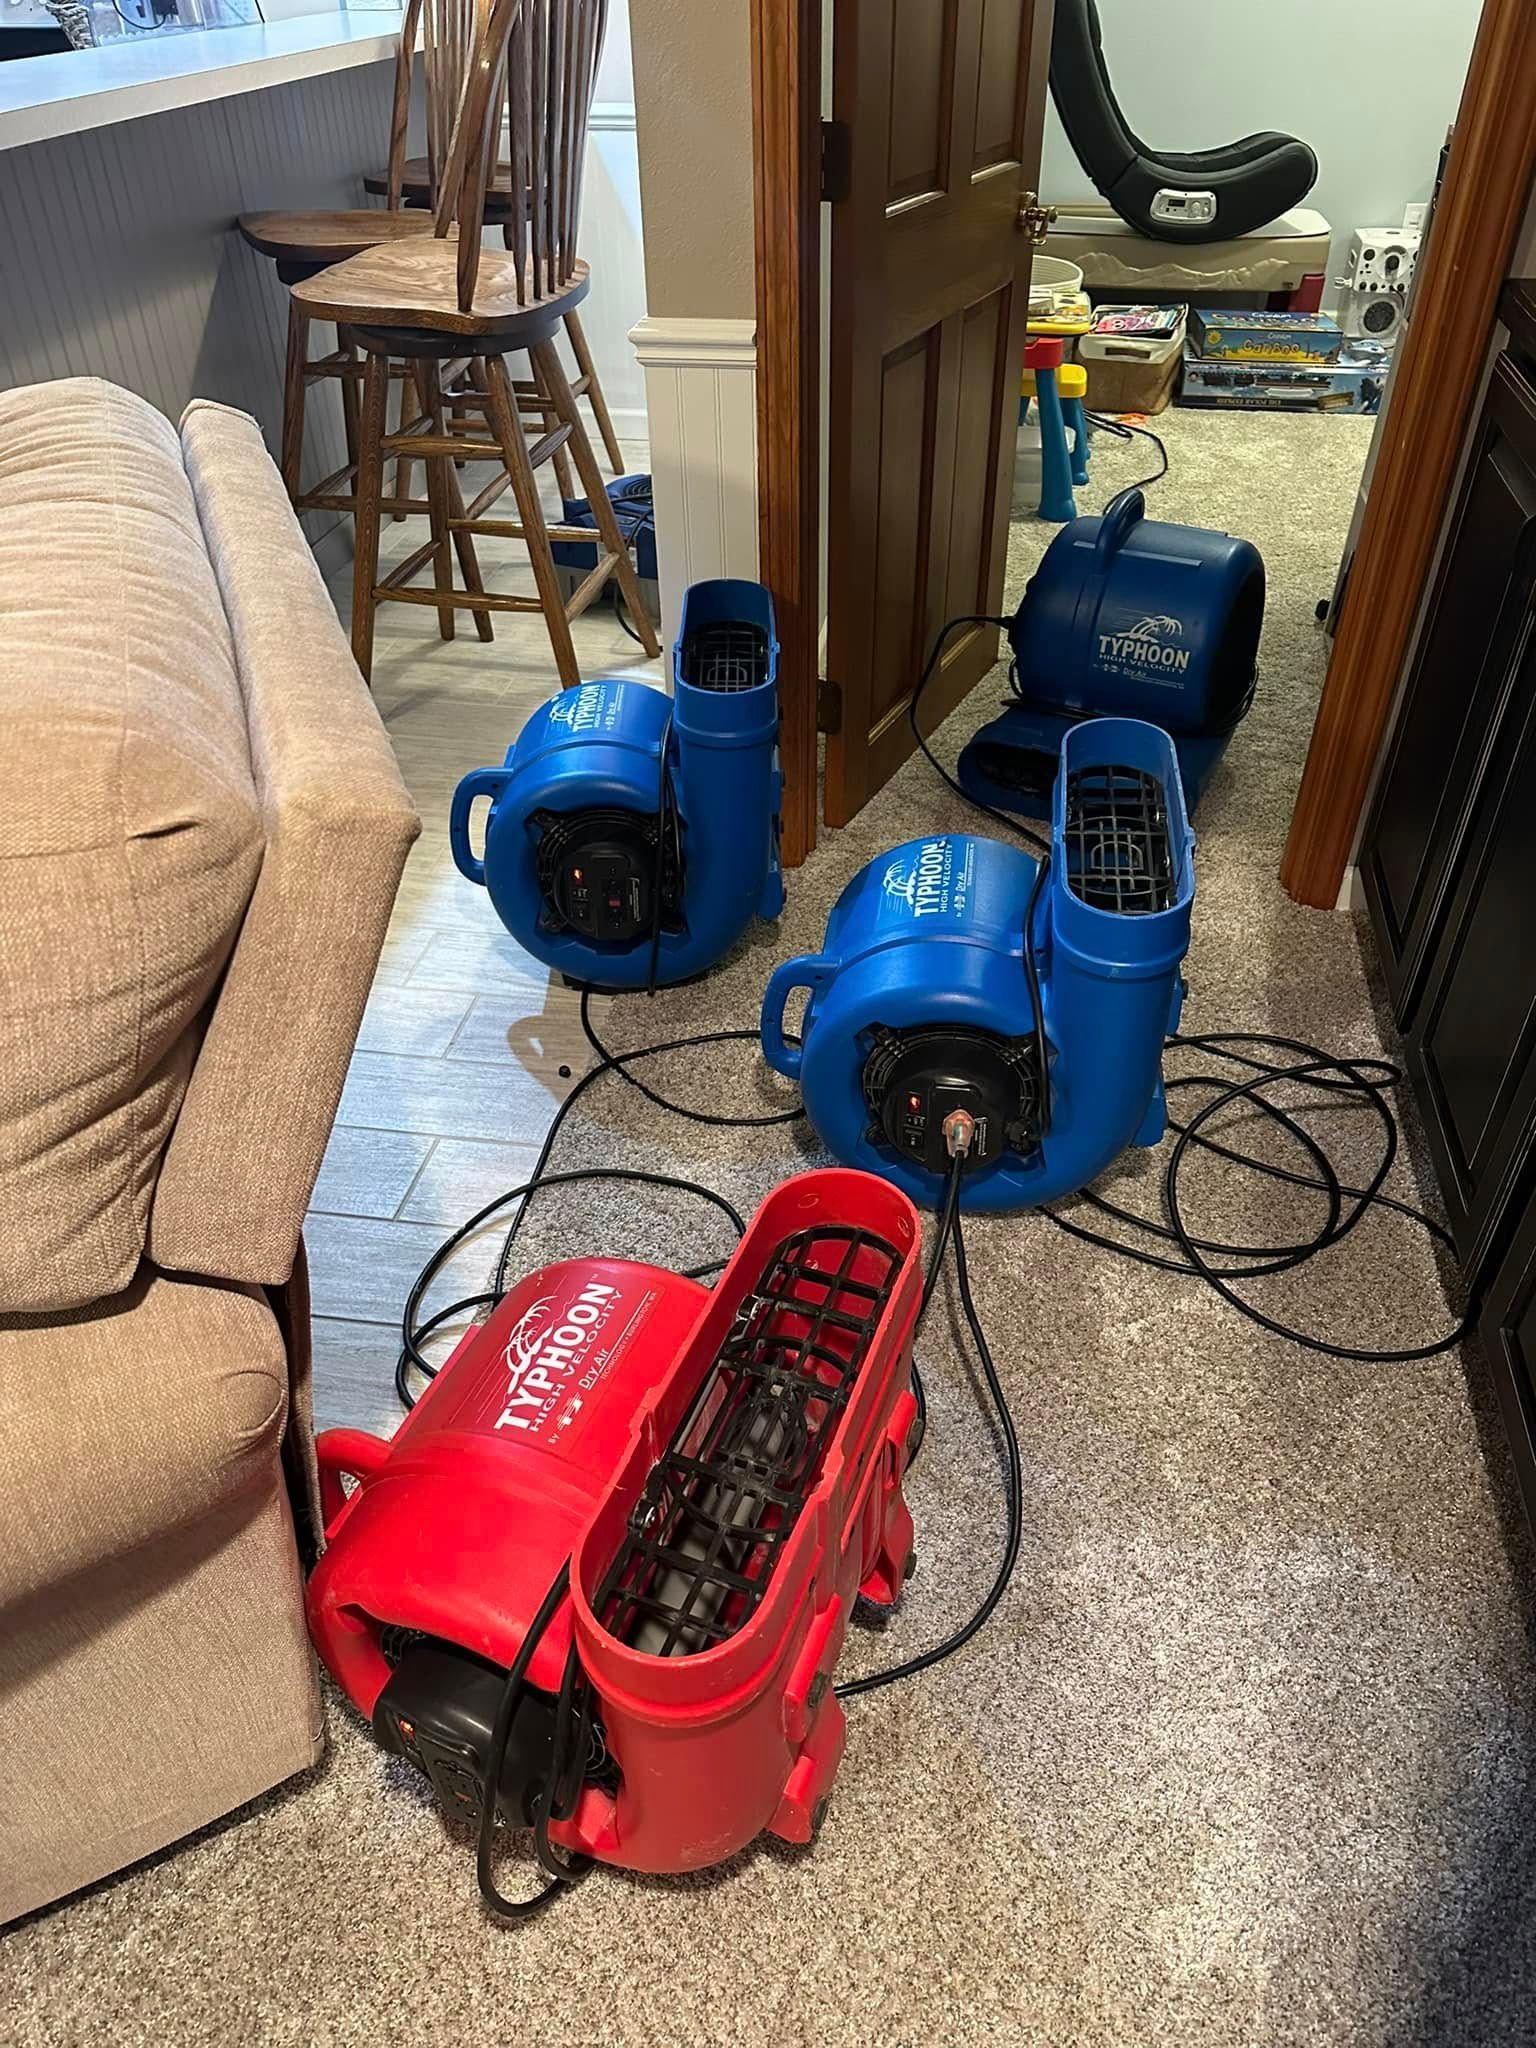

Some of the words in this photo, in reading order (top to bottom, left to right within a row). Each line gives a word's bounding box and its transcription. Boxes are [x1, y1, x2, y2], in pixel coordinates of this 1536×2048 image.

[1099, 635, 1190, 669] TYPHOON
[1099, 654, 1126, 663] HIGH
[1129, 659, 1184, 675] VELOCITY
[572, 685, 600, 733] TYPHOON
[914, 843, 945, 917] TYPHOON
[942, 844, 953, 887] VELOCITY
[940, 889, 949, 913] HIGH
[494, 1282, 615, 1430] TYPHOON
[529, 1384, 566, 1432] HIGH
[563, 1289, 623, 1377] VELOCITY
[578, 1366, 599, 1390] Dry
[595, 1348, 610, 1370] Air
[601, 1341, 627, 1380] TECHNOLOGY
